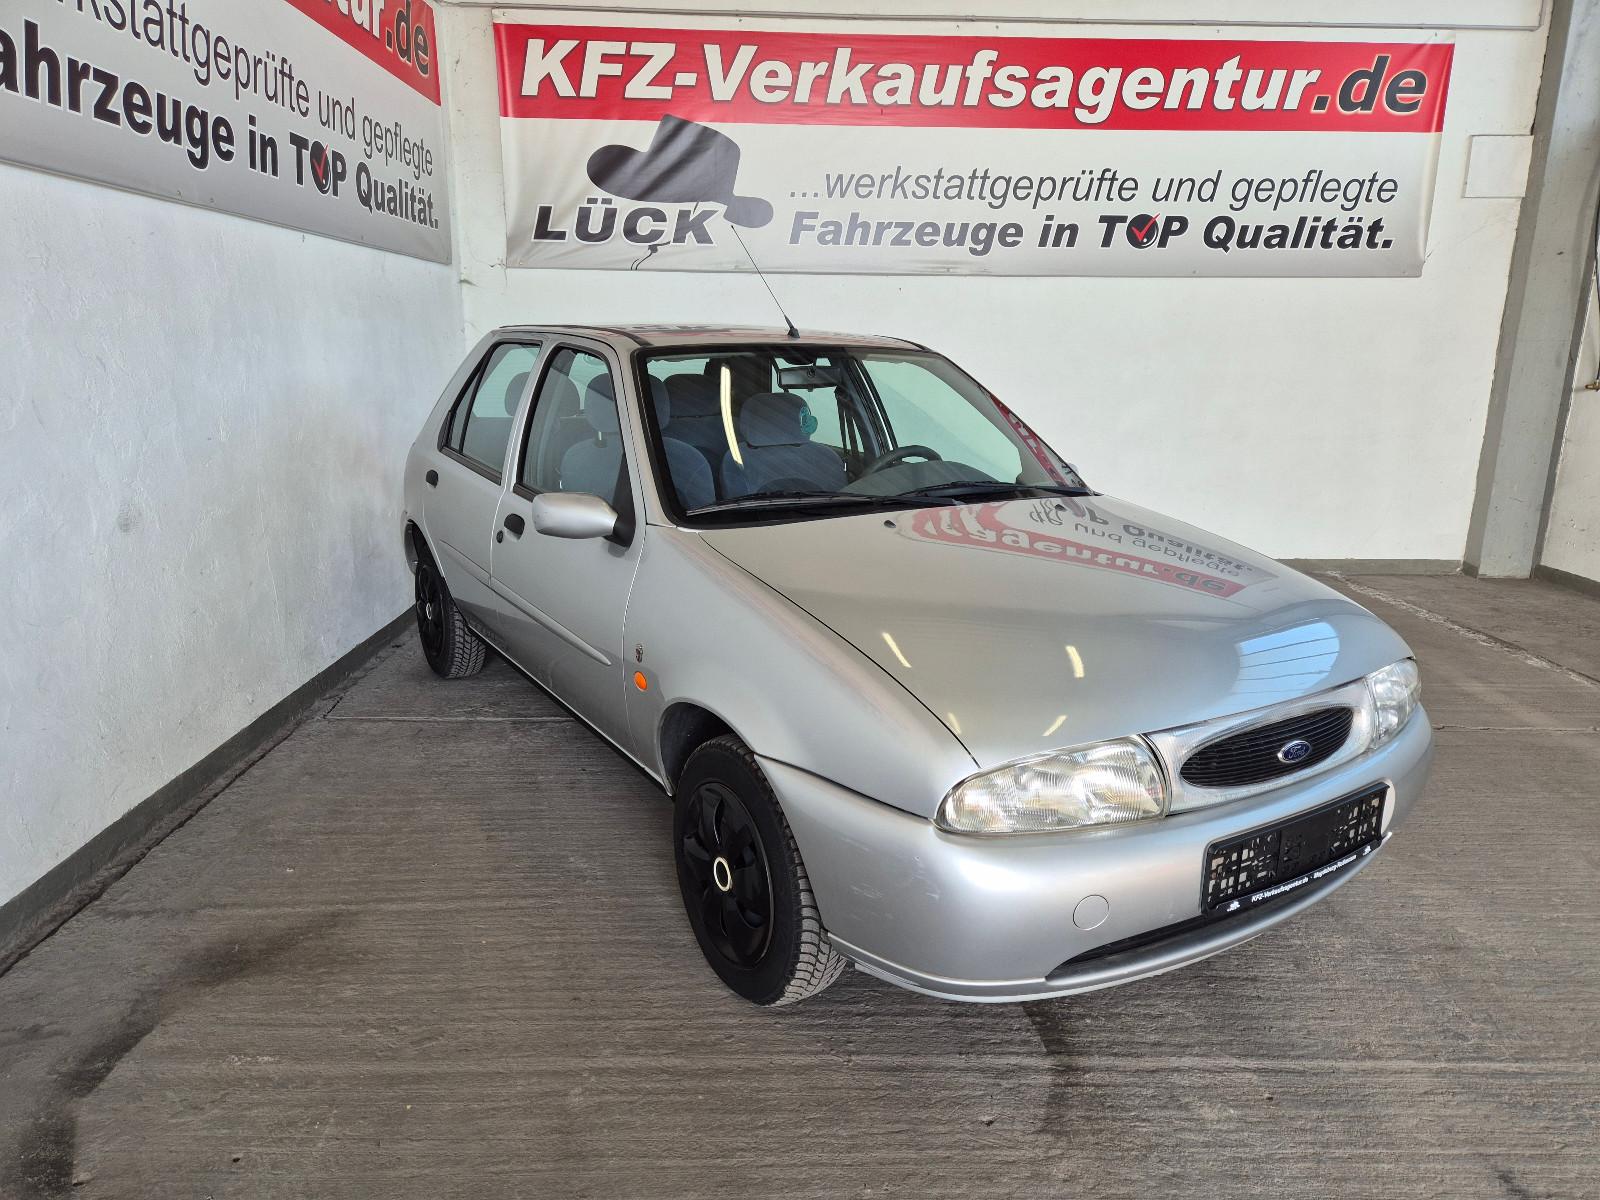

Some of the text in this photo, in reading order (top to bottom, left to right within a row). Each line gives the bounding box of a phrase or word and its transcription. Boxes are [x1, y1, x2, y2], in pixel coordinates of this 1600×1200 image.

[520, 37, 1428, 124] KFZ-Verkaufsagentur.de
[318, 90, 356, 141] und
[362, 111, 433, 180] gepflegte
[248, 115, 279, 177] in
[289, 131, 347, 196] TOP
[355, 161, 439, 229] Qualität.
[789, 165, 1399, 211] ...werkstattgeprüfte und gepflegte
[532, 197, 719, 246] LÜCK
[788, 211, 1394, 257] Fahrzeuge in TOP Qualität.
